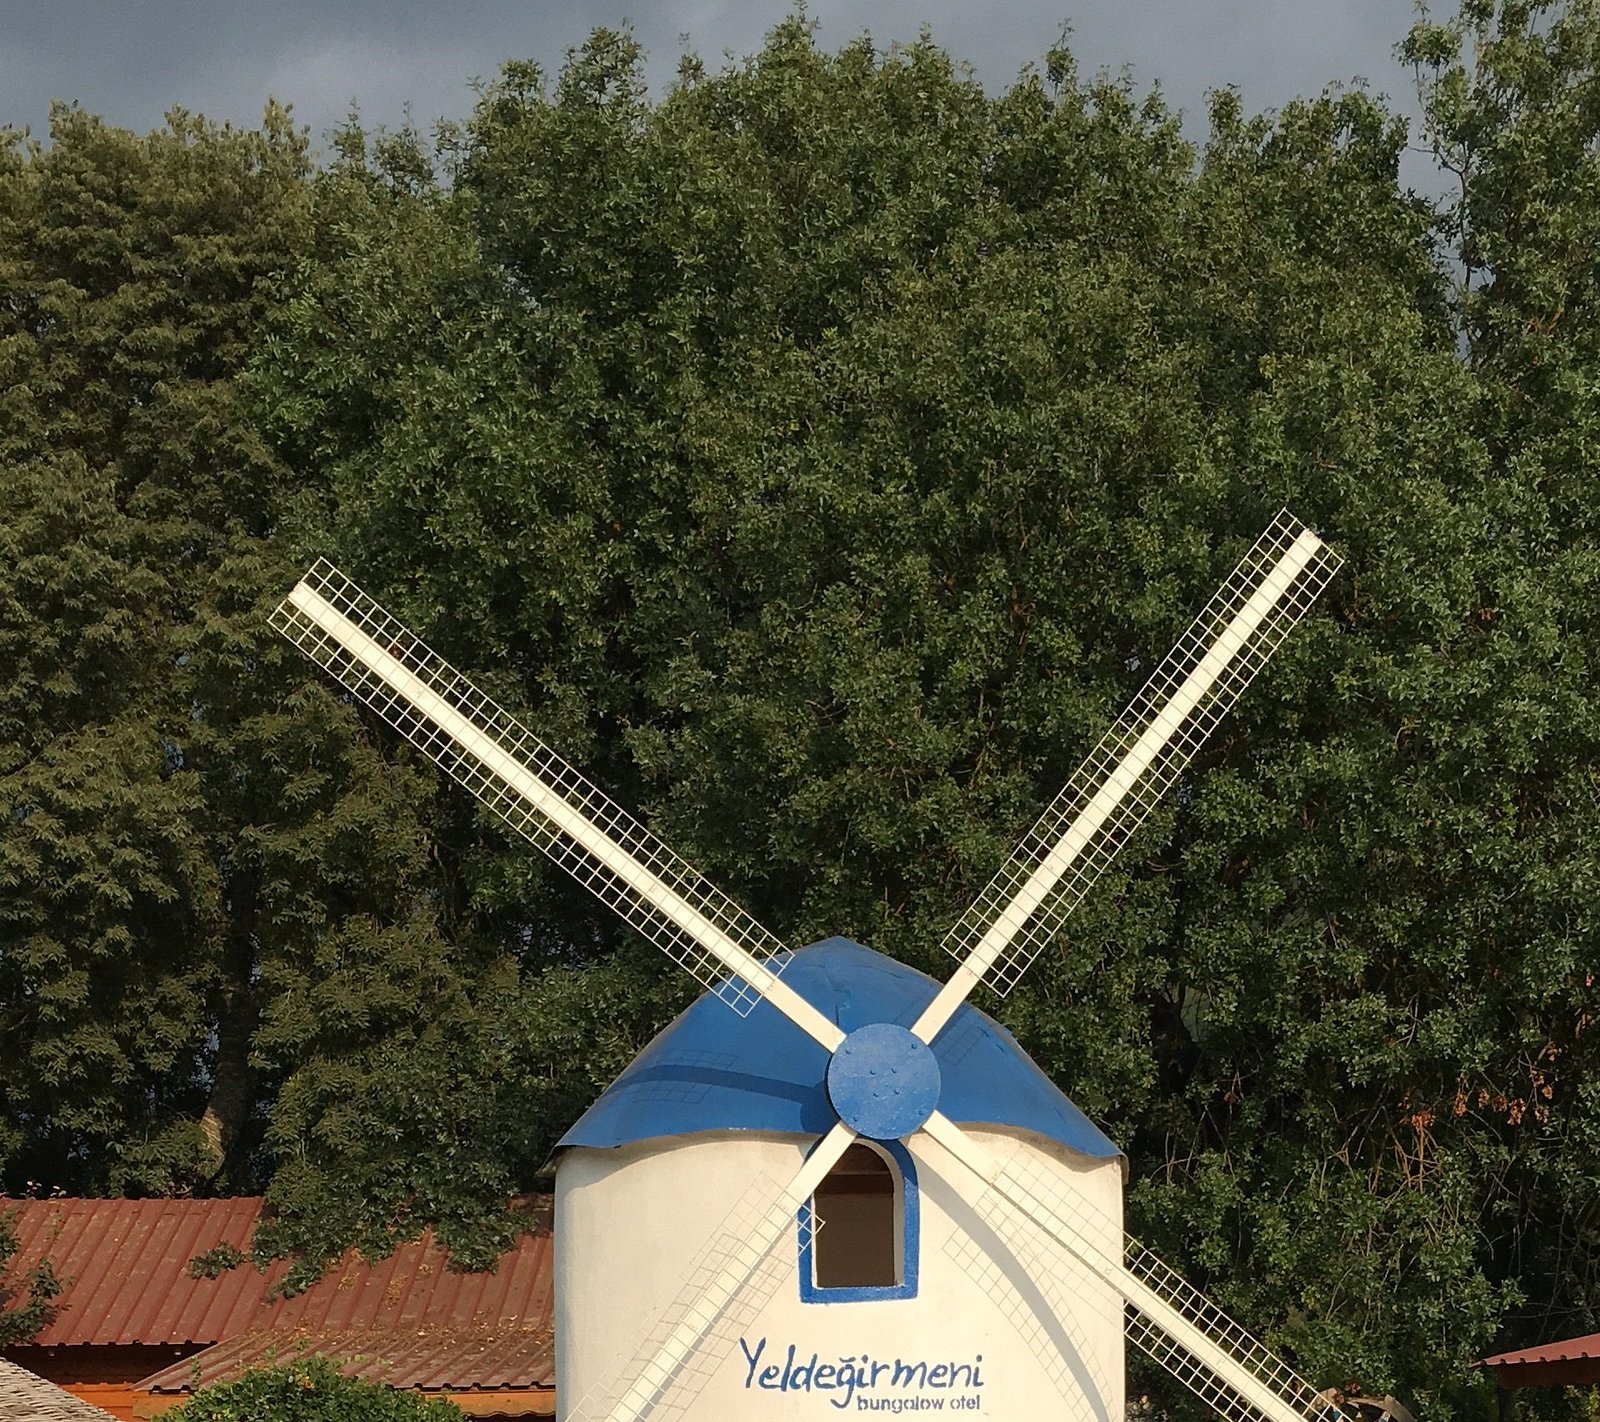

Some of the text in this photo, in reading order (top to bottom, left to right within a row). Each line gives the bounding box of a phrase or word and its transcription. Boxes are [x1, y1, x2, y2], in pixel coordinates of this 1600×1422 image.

[740, 1337, 984, 1409] Yeldeğirmeni
[857, 1395, 980, 1413] bungalow otel
